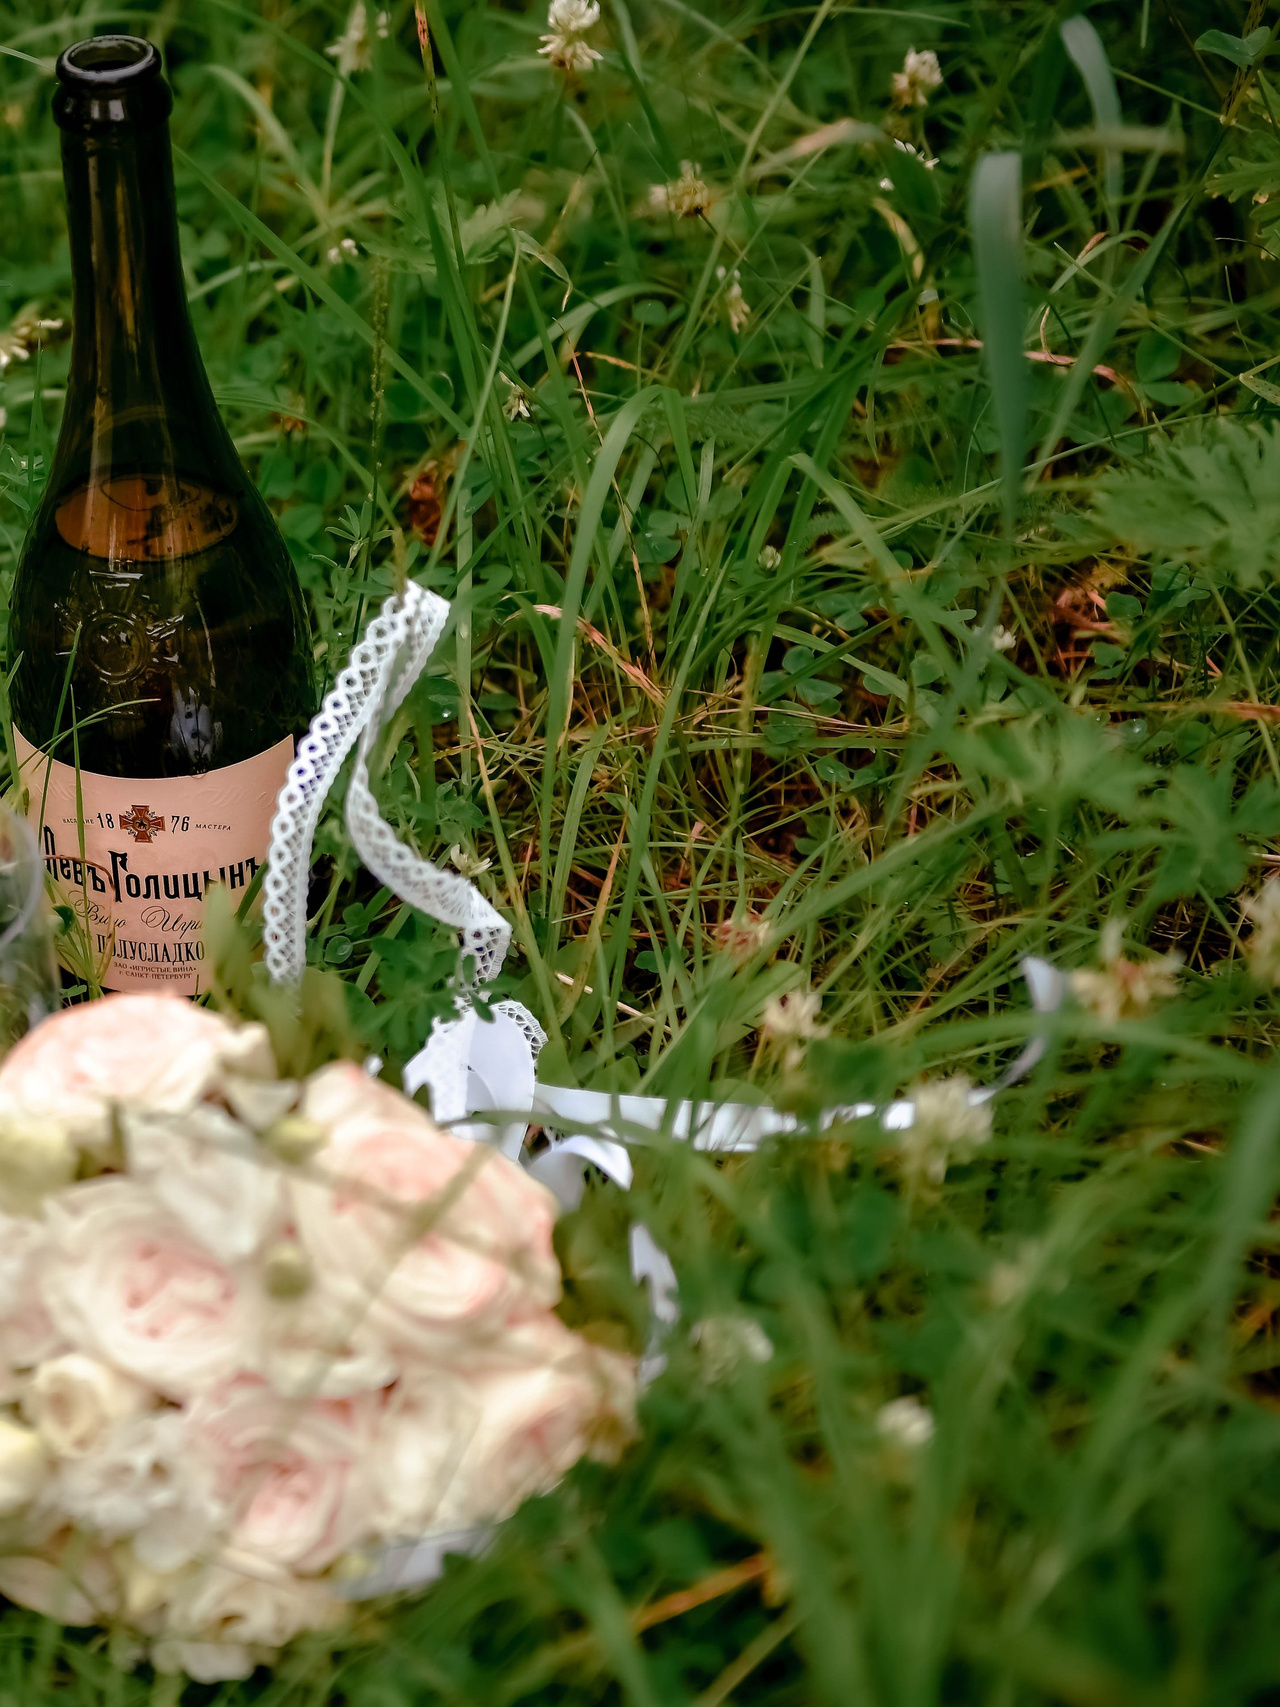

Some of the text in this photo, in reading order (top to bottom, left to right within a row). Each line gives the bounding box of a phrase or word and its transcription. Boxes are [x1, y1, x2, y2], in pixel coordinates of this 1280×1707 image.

[96, 812, 114, 829] 18
[170, 815, 190, 834] 76
[195, 823, 231, 831] МАСТЕРА
[43, 825, 106, 893] Левъ
[113, 961, 197, 973] ЗАО «ИГРИСТЫЕ ВИНА»
